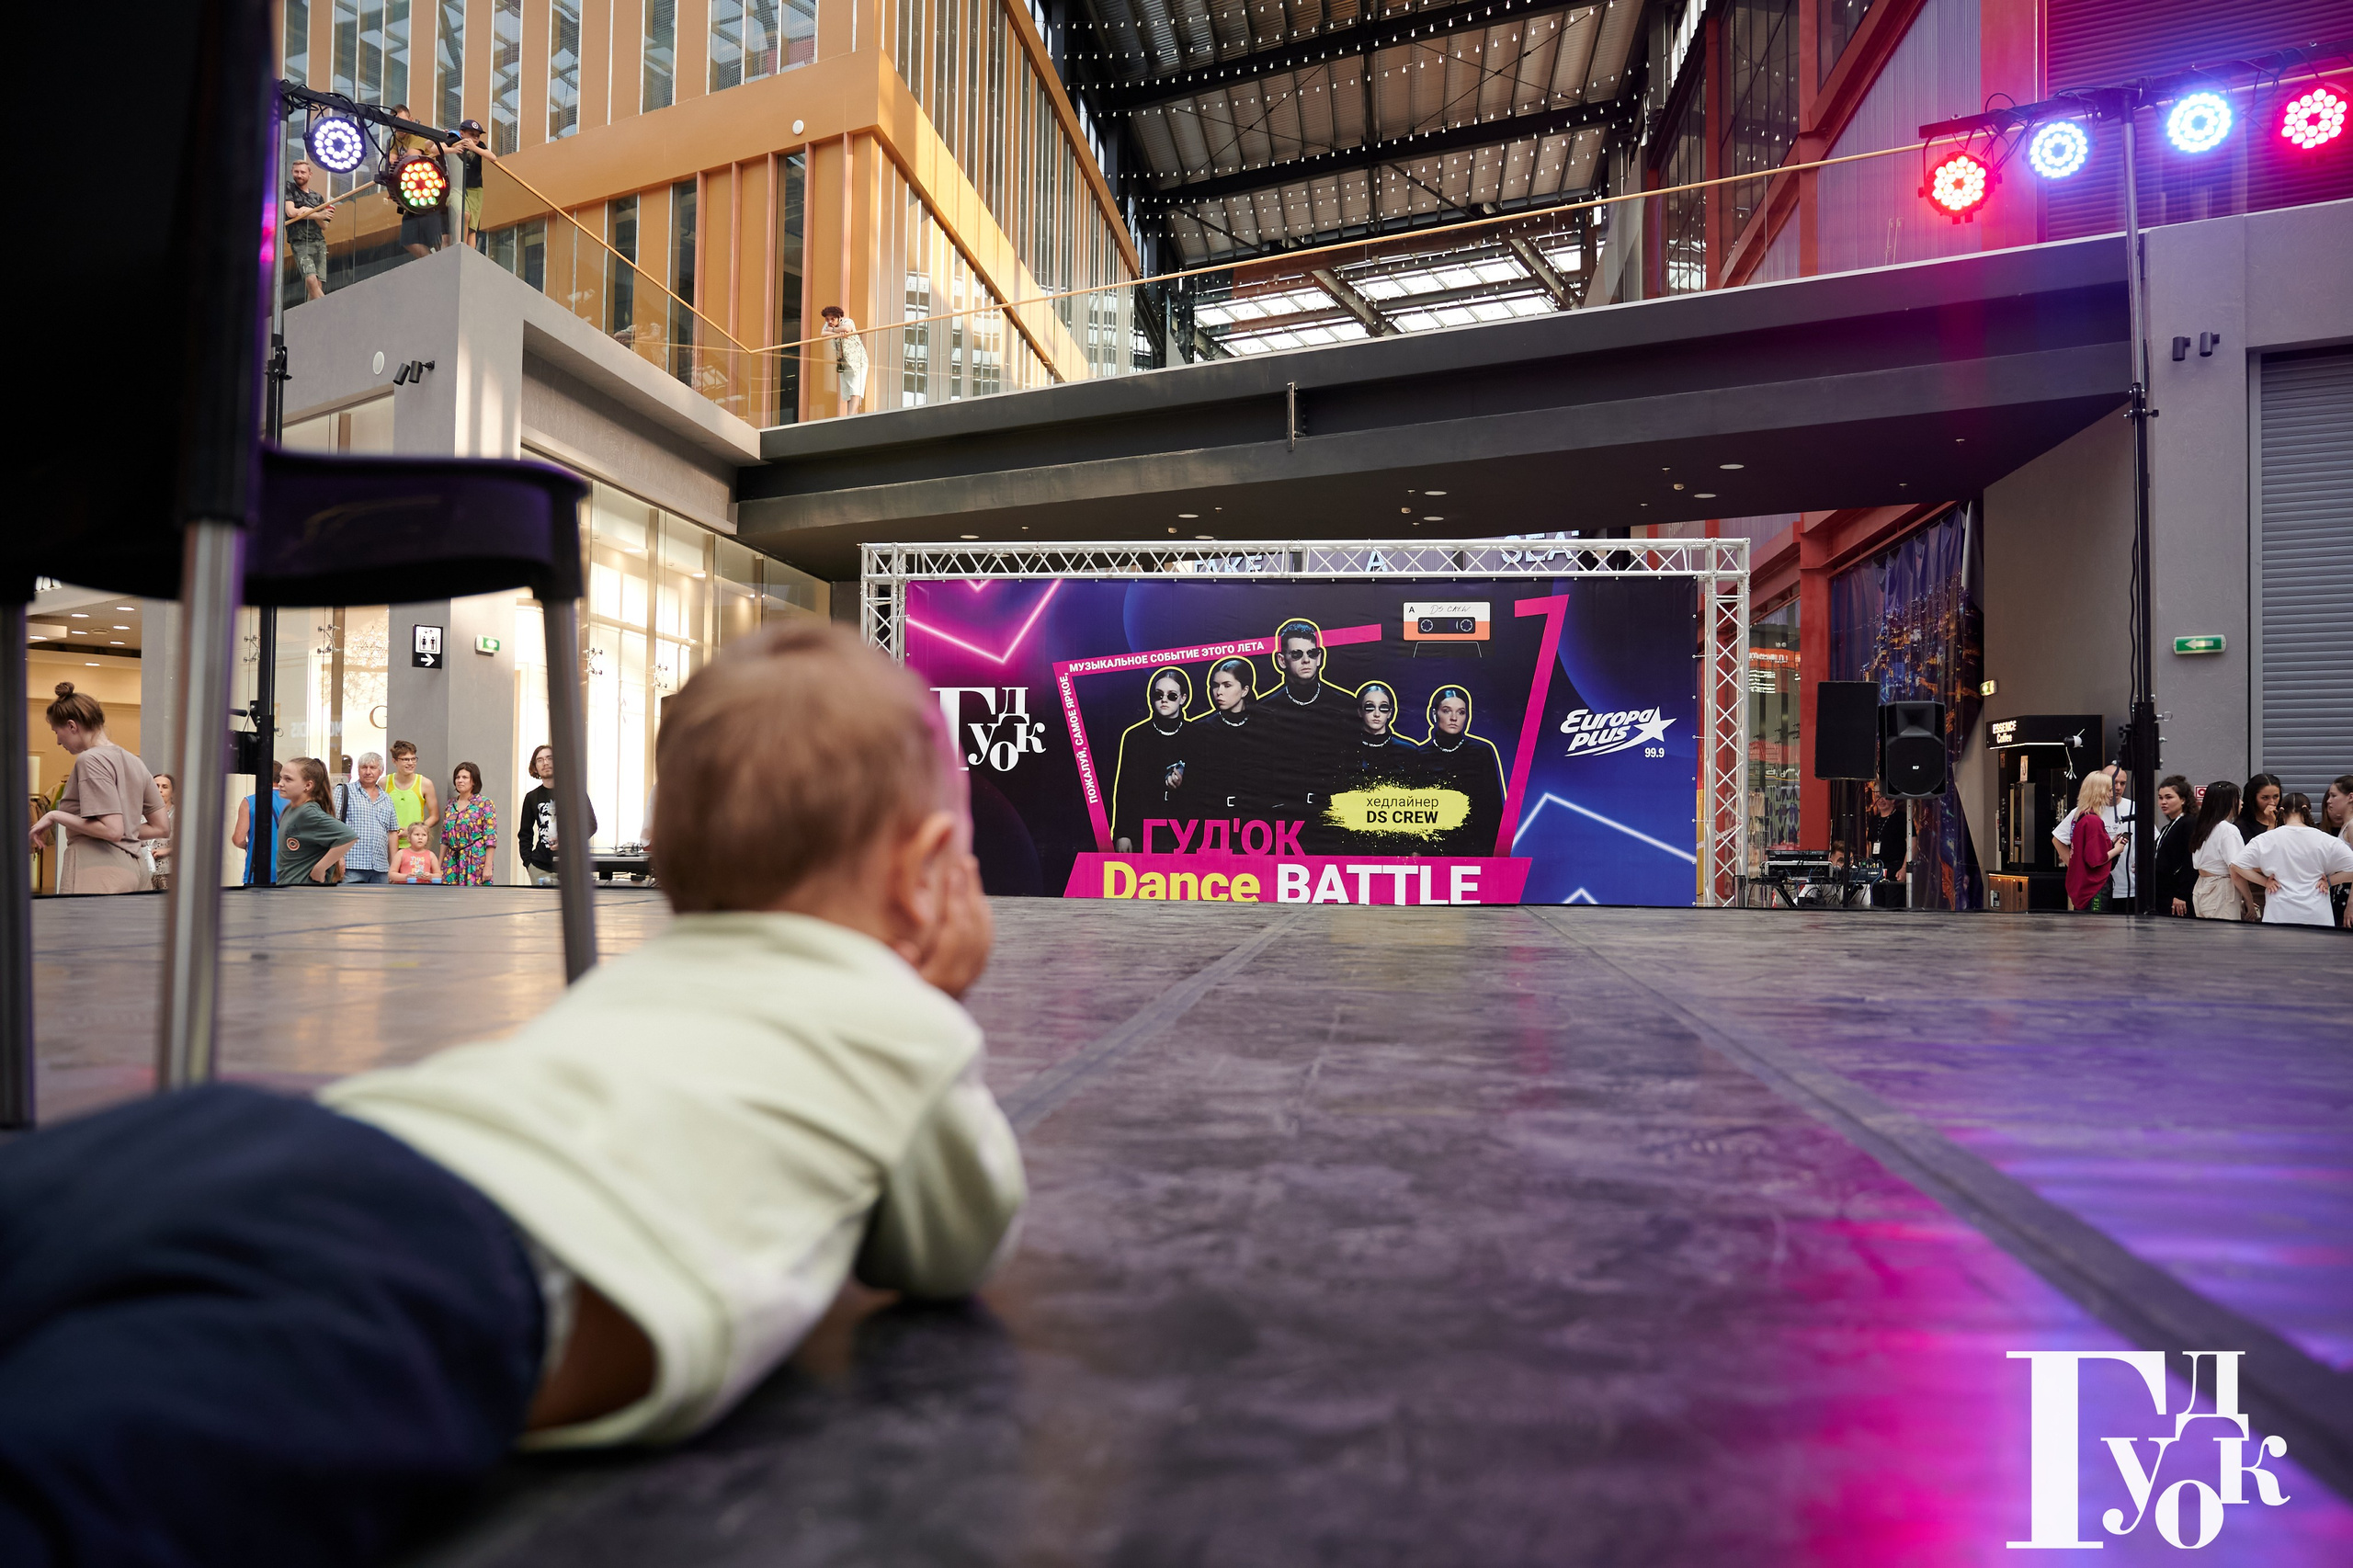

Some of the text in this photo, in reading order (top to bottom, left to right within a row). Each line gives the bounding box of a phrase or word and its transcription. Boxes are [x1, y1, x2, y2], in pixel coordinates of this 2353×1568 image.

[1069, 641, 1265, 673] МУЗЫКАЛЬНОЕ СОБЫТИЕ ЭТОГО ЛЕТА
[1059, 672, 1098, 804] ПОЖАЛУЙ, САМОЕ ЯРКОЕ,
[1993, 721, 2017, 734] ESSENCE
[1644, 747, 1665, 757] 99.9
[1366, 796, 1439, 810] хедлайнер
[1367, 811, 1439, 824] DS CREW
[1142, 818, 1305, 856] ГУД'ОК
[1104, 861, 1482, 905] Dance BATTLE
